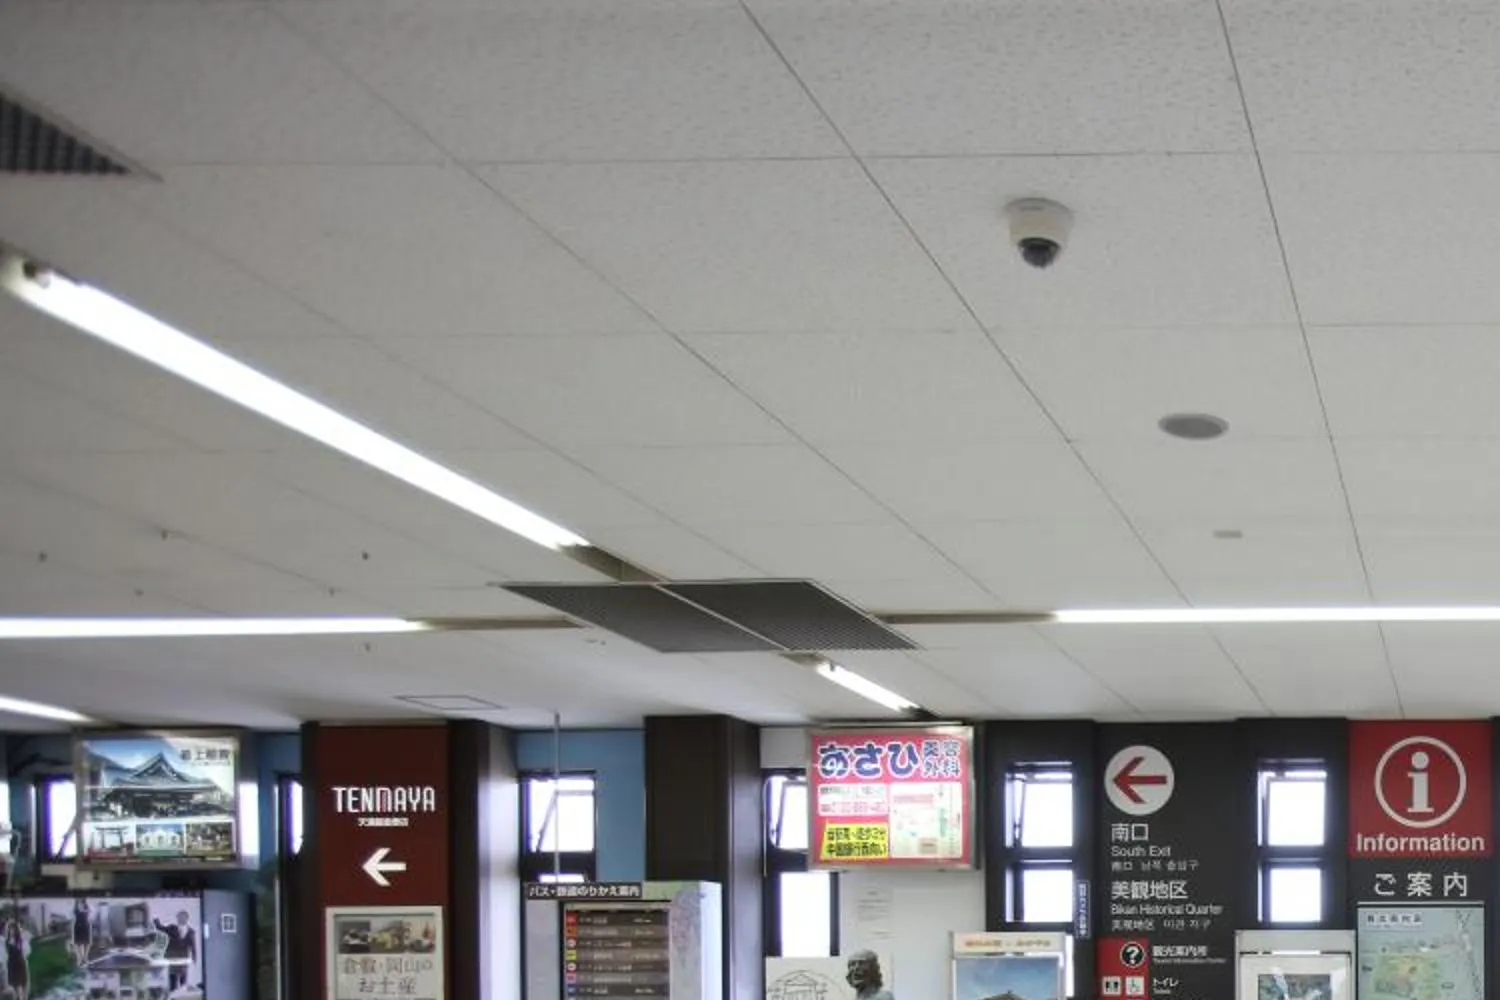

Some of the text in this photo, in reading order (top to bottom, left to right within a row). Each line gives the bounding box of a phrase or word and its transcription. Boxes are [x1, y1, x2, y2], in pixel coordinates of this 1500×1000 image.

[819, 742, 919, 778] あさひ
[332, 786, 436, 813] TENMAYA
[1111, 823, 1149, 841] 南口
[1111, 846, 1172, 857] South Exit
[1357, 833, 1485, 852] Information
[1111, 880, 1188, 899] 美観地区
[1374, 872, 1467, 897] ご案内
[1186, 904, 1223, 915] Quarter
[1153, 977, 1179, 987] トイレ
